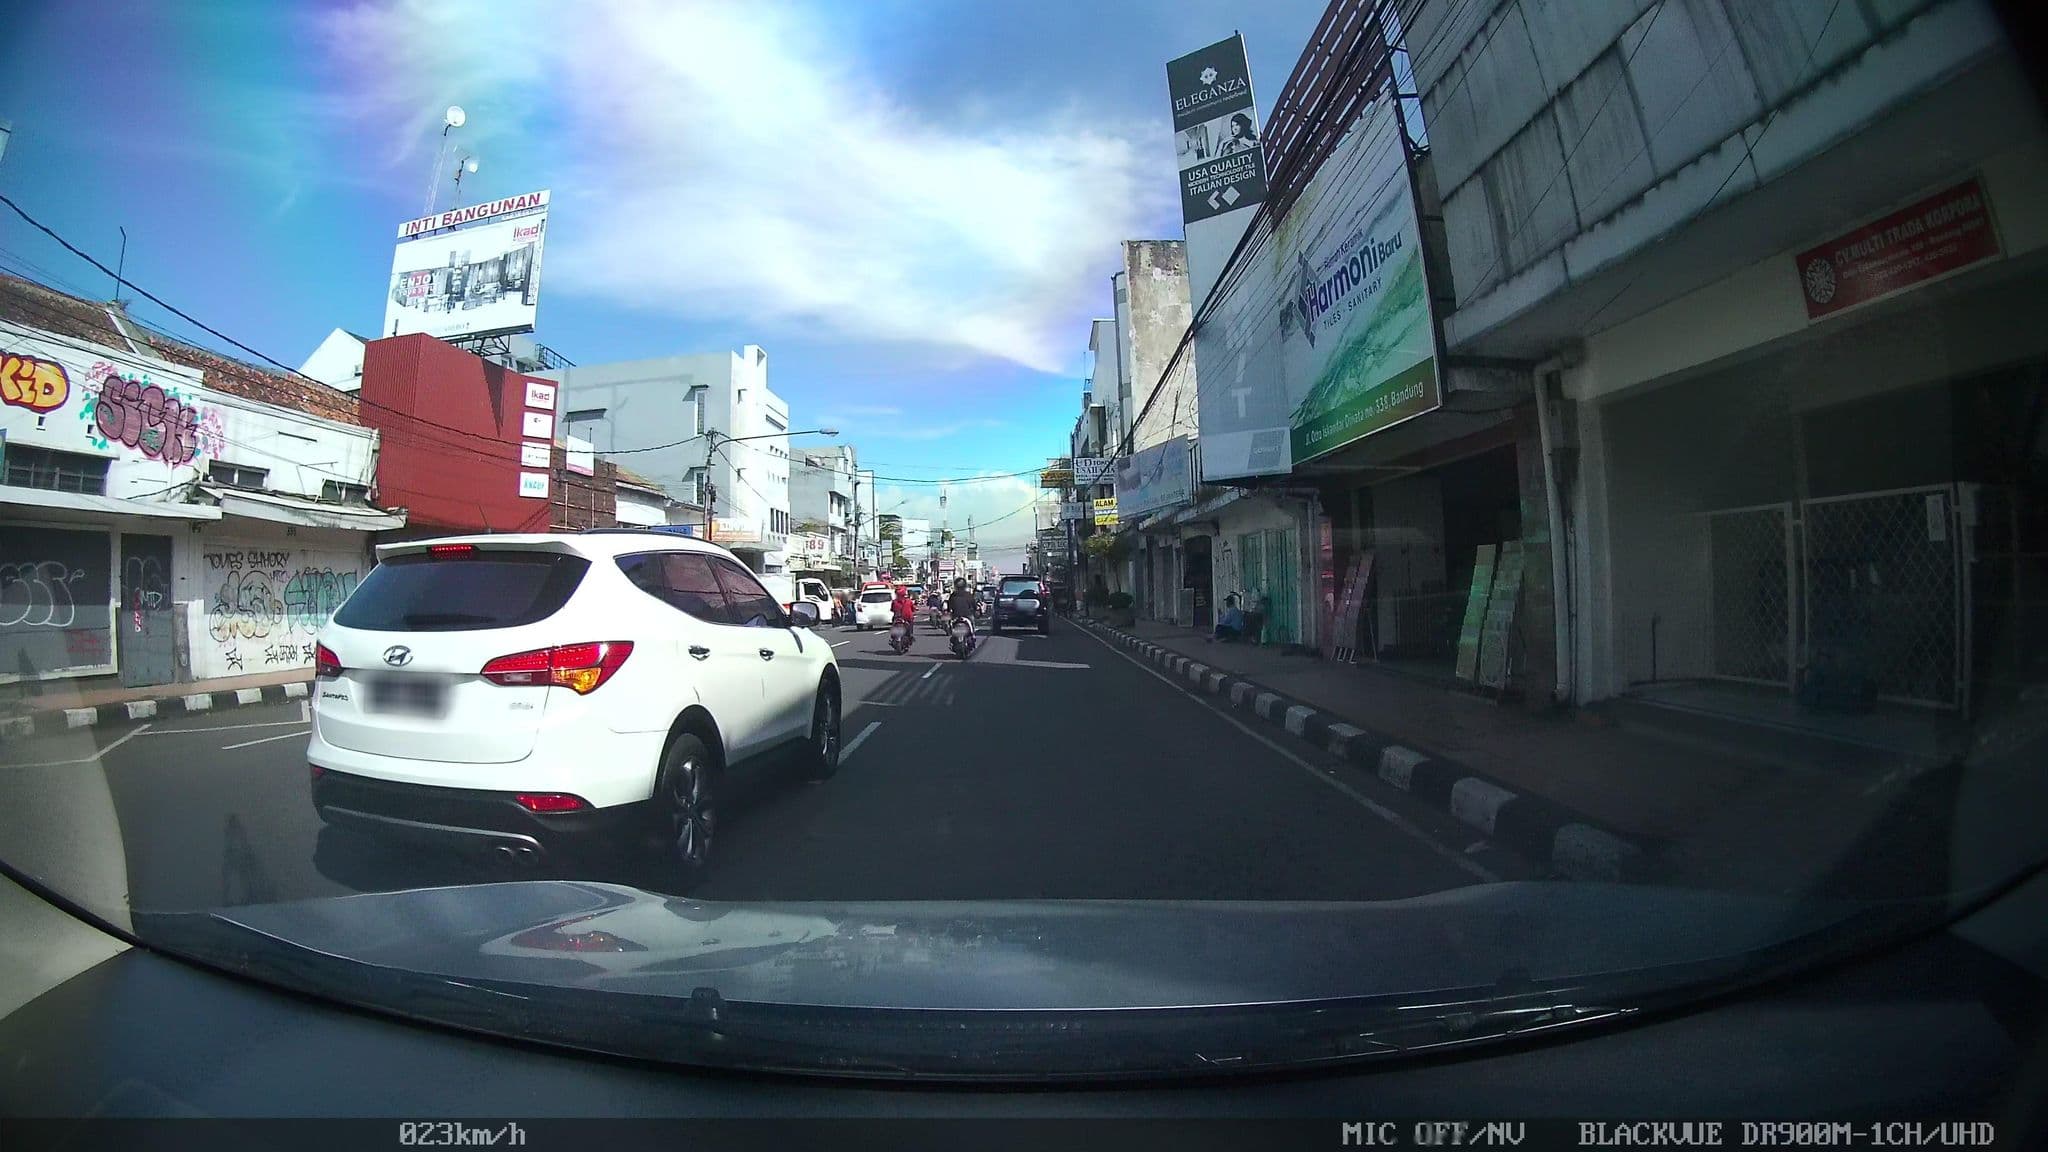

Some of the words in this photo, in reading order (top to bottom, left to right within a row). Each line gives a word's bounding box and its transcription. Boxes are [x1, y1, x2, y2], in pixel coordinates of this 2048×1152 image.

[1176, 77, 1247, 111] ELEGANZA
[1188, 167, 1209, 181] USA
[1210, 153, 1253, 173] QUALITY
[1190, 179, 1222, 196] ITALIAN
[1224, 169, 1256, 185] DESIGN
[405, 217, 437, 236] INTI
[441, 193, 541, 226] BANGUNAN
[1308, 238, 1378, 323] Harmoni
[1379, 231, 1403, 264] Baru
[1323, 310, 1342, 330] TILES
[1347, 276, 1382, 312] SANITARY
[1391, 381, 1424, 407] Bandung
[1095, 499, 1114, 507] ALAM
